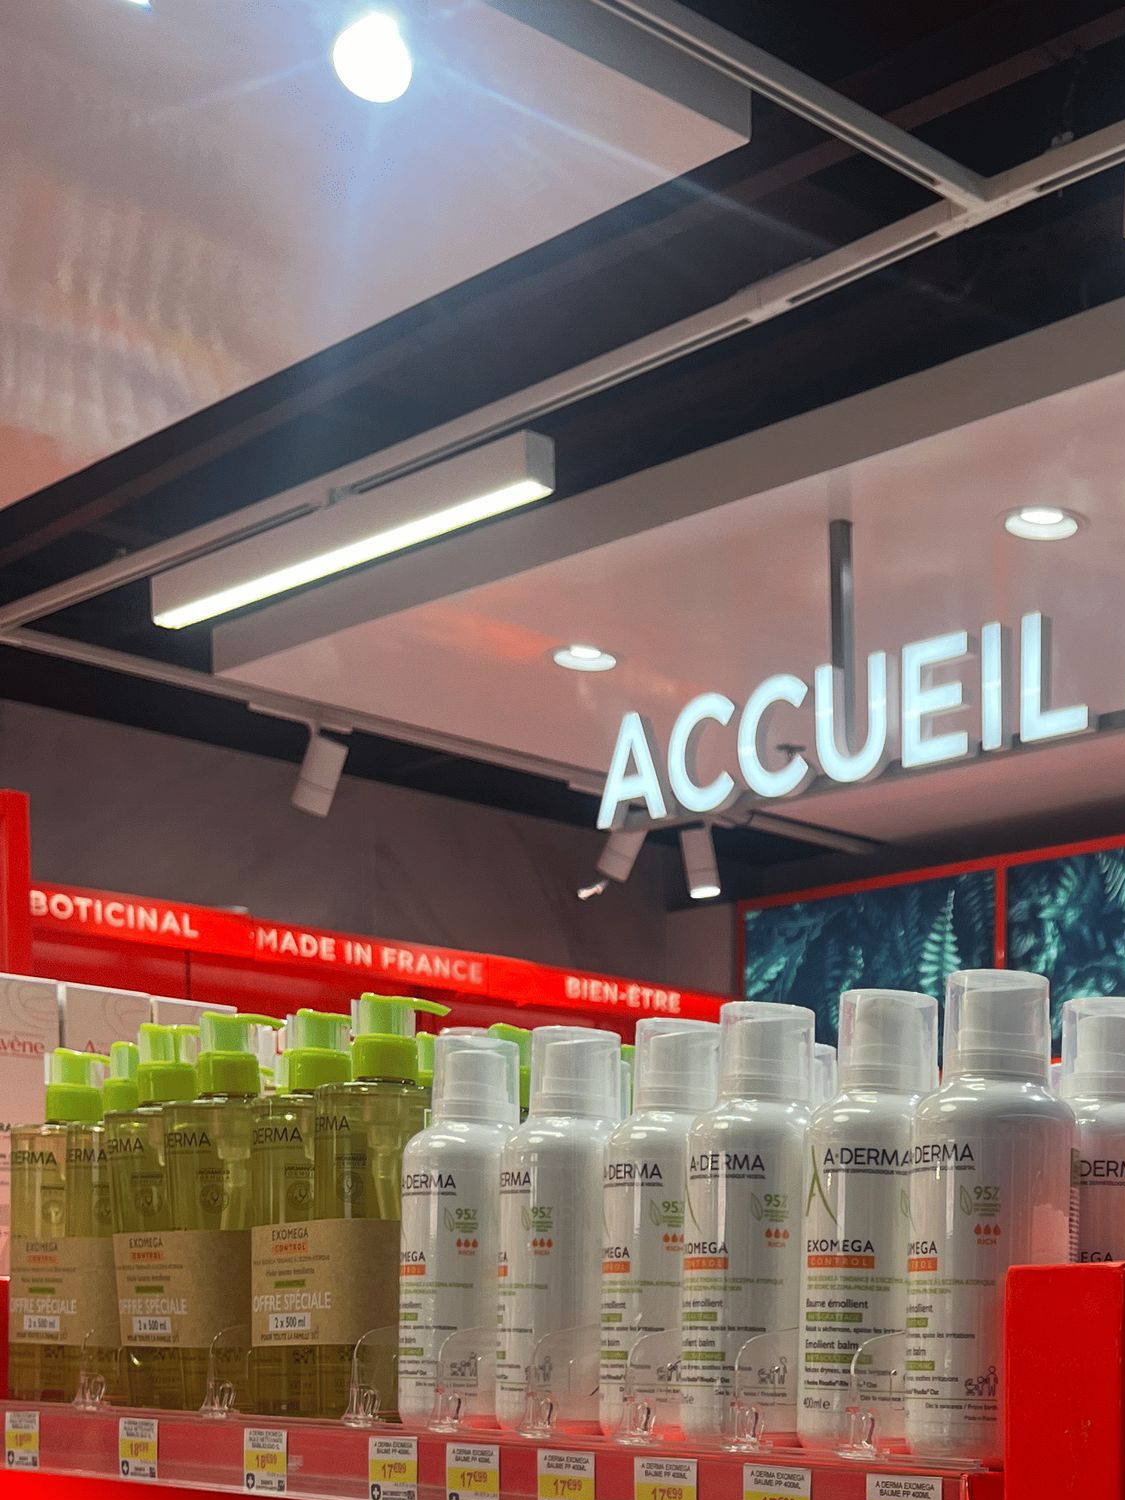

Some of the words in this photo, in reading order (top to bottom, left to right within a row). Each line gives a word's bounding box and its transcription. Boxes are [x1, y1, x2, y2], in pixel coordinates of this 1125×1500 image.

[596, 610, 1089, 831] ACCUEIL
[29, 889, 199, 939] BOTICINAL
[257, 928, 336, 964] MADE
[344, 938, 373, 966] IN
[381, 945, 483, 985] FRANCE
[565, 974, 682, 1015] BIEN-ÊTRE
[272, 1228, 308, 1241] EXOMEGA
[807, 1239, 874, 1253] EXOMEGA
[810, 1257, 868, 1266] CONTROL
[253, 1294, 281, 1312] OFFRE
[284, 1289, 331, 1310] SPÉCIALE
[828, 1298, 868, 1309] émollient
[275, 1318, 278, 1328] 2
[280, 1320, 284, 1328] x
[286, 1317, 297, 1328] 500
[298, 1316, 306, 1327] ml
[838, 1340, 859, 1350] balm
[757, 1471, 775, 1480] DERMA
[776, 1472, 805, 1482] EXOMEGA
[882, 1481, 902, 1490] DERMA
[904, 1481, 935, 1491] EXOMEGA
[880, 1488, 901, 1497] BAUME
